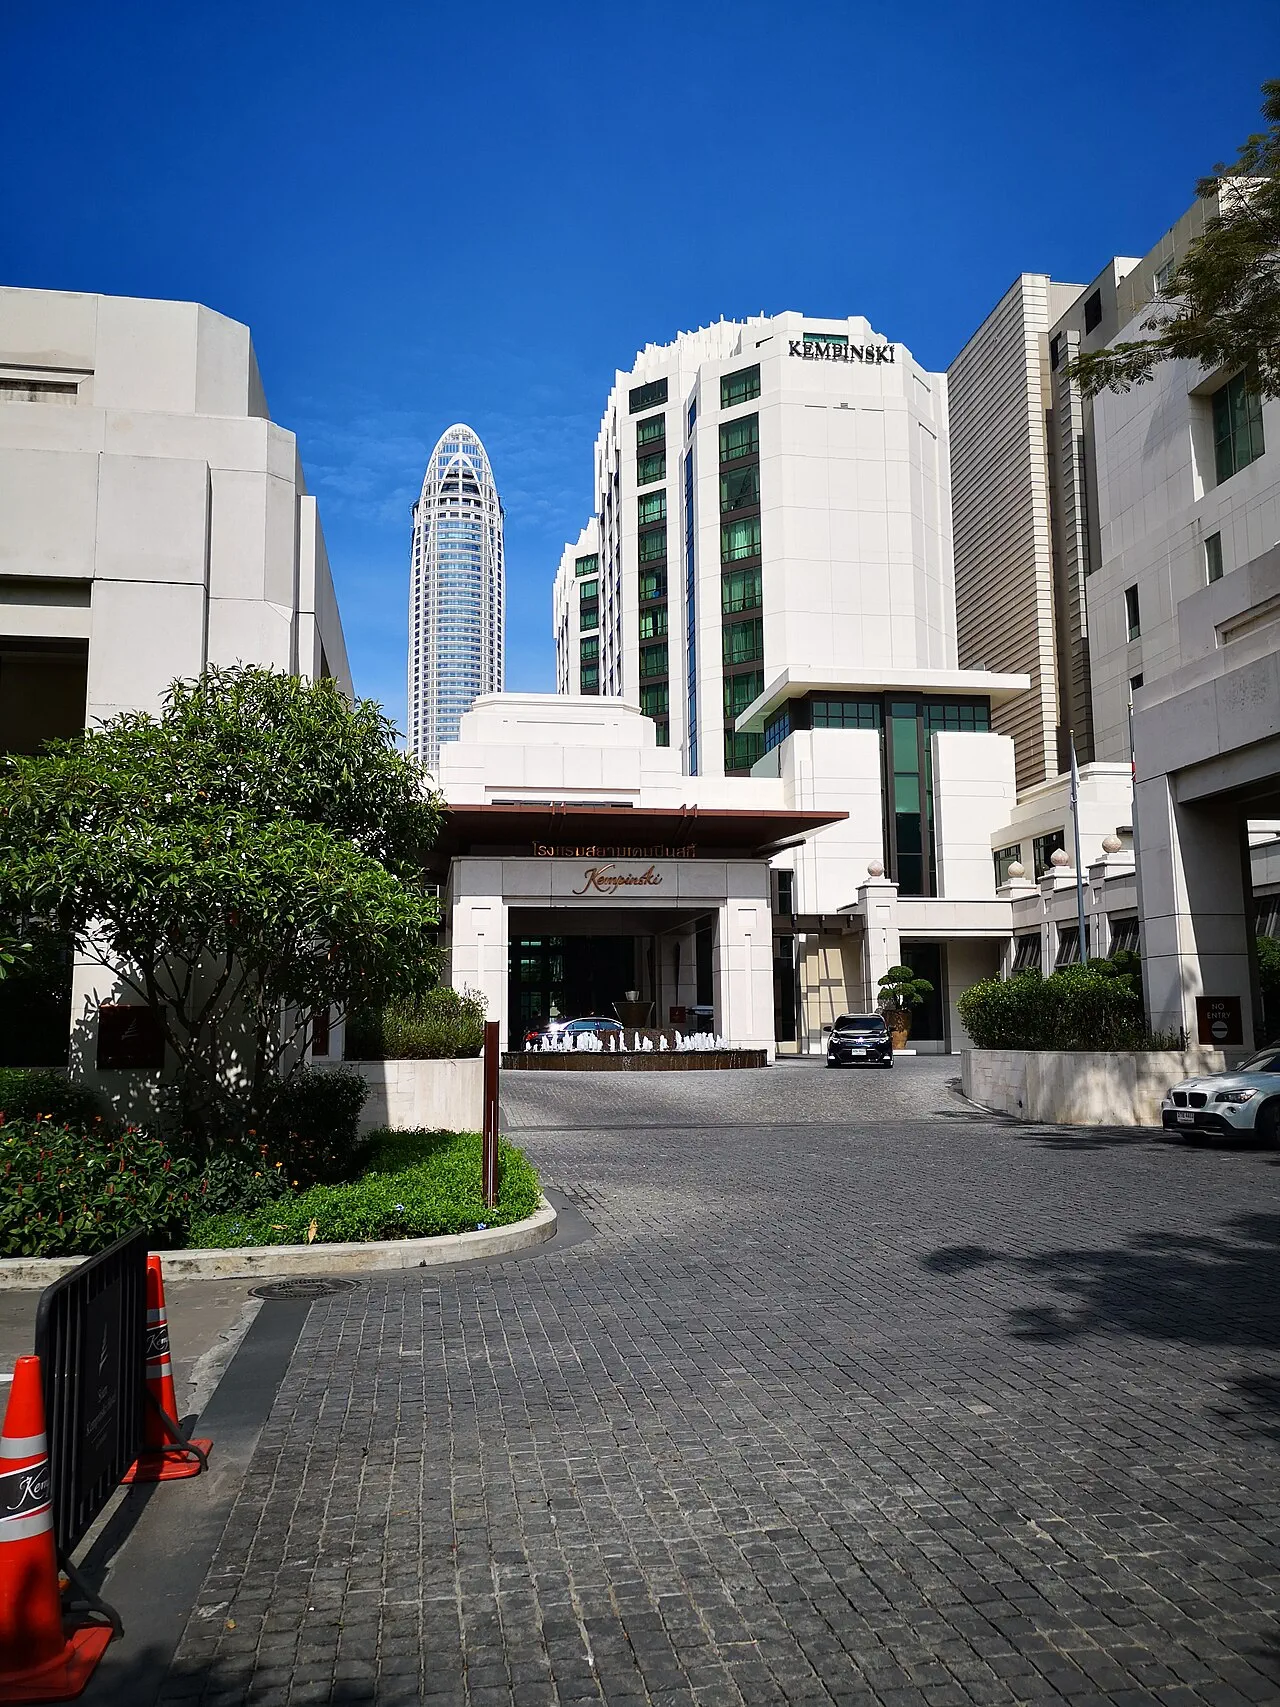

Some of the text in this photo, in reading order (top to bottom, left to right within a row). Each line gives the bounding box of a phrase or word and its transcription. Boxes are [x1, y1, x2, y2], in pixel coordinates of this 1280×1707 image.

[788, 340, 895, 364] KEMPINSKI
[572, 863, 663, 895] Kempinski
[1207, 1011, 1231, 1019] ENTRY
